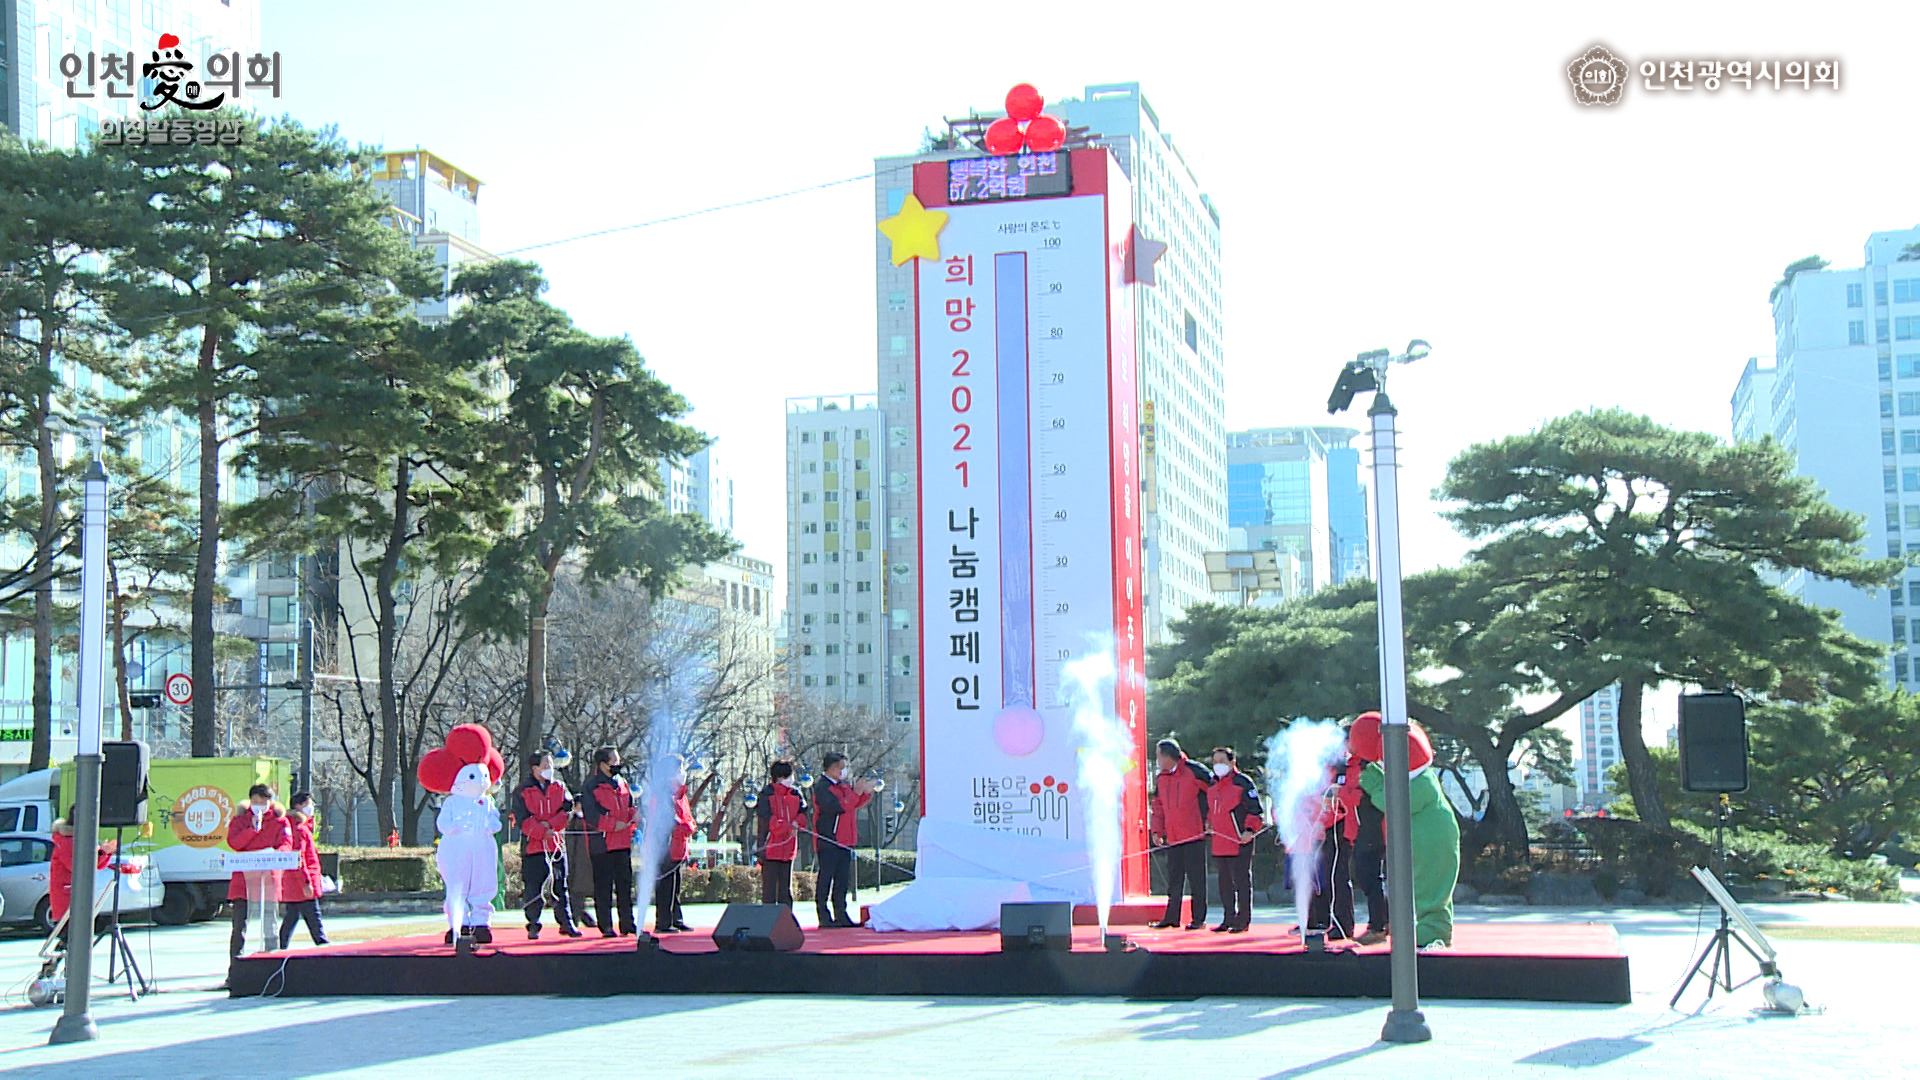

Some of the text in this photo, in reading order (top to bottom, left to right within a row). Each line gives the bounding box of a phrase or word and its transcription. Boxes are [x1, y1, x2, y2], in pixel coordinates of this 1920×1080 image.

[997, 221, 1027, 234] 사랑의
[1044, 237, 1061, 247] 100
[1050, 283, 1062, 292] 90
[1050, 327, 1063, 337] 80
[1052, 373, 1064, 382] 70
[1053, 419, 1065, 428] 60
[1054, 464, 1066, 473] 50
[945, 254, 980, 710] 희망 2021 나눔캠페인
[1054, 510, 1067, 520] 40
[1056, 557, 1068, 566] 30
[1056, 603, 1069, 613] 20
[1057, 650, 1070, 659] 10
[172, 682, 190, 696] 30
[973, 775, 1027, 798] 나눔으로
[973, 801, 1013, 824] 희망을
